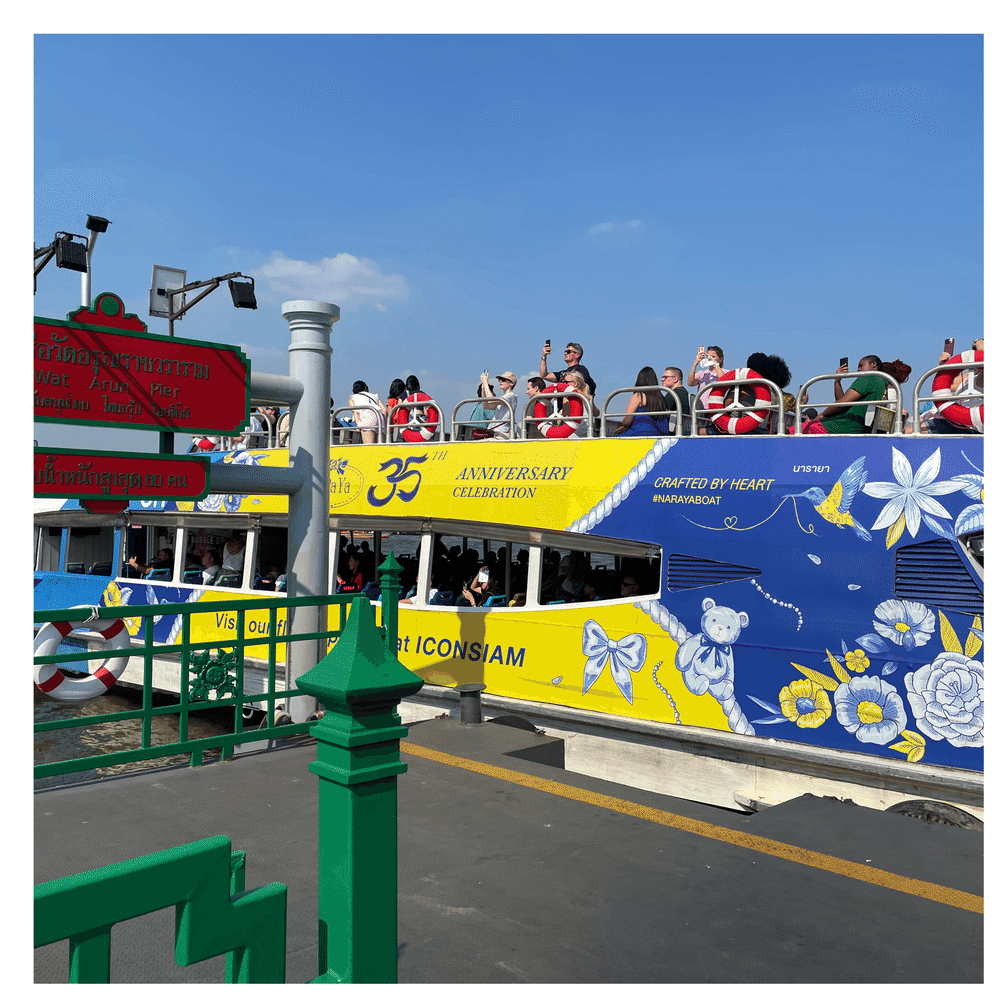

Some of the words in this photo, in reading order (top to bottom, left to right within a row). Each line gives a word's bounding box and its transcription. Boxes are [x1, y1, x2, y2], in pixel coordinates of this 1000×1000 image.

[34, 331, 209, 379] อวัดอรุณราชวราราม
[34, 369, 69, 388] Wat
[89, 376, 129, 394] Arun
[150, 382, 181, 398] Pier
[455, 465, 574, 481] ANNIVERSARY
[793, 464, 831, 473] นารายา
[167, 475, 189, 488] คน
[367, 452, 429, 508] 35
[654, 476, 708, 489] CRAFTED
[709, 477, 729, 490] BY
[729, 478, 775, 491] HEART
[452, 486, 537, 499] CELEBRATION
[652, 494, 722, 506] #NARAYABOAT
[215, 612, 238, 631] Vis
[415, 635, 526, 668] ICONSIAM
